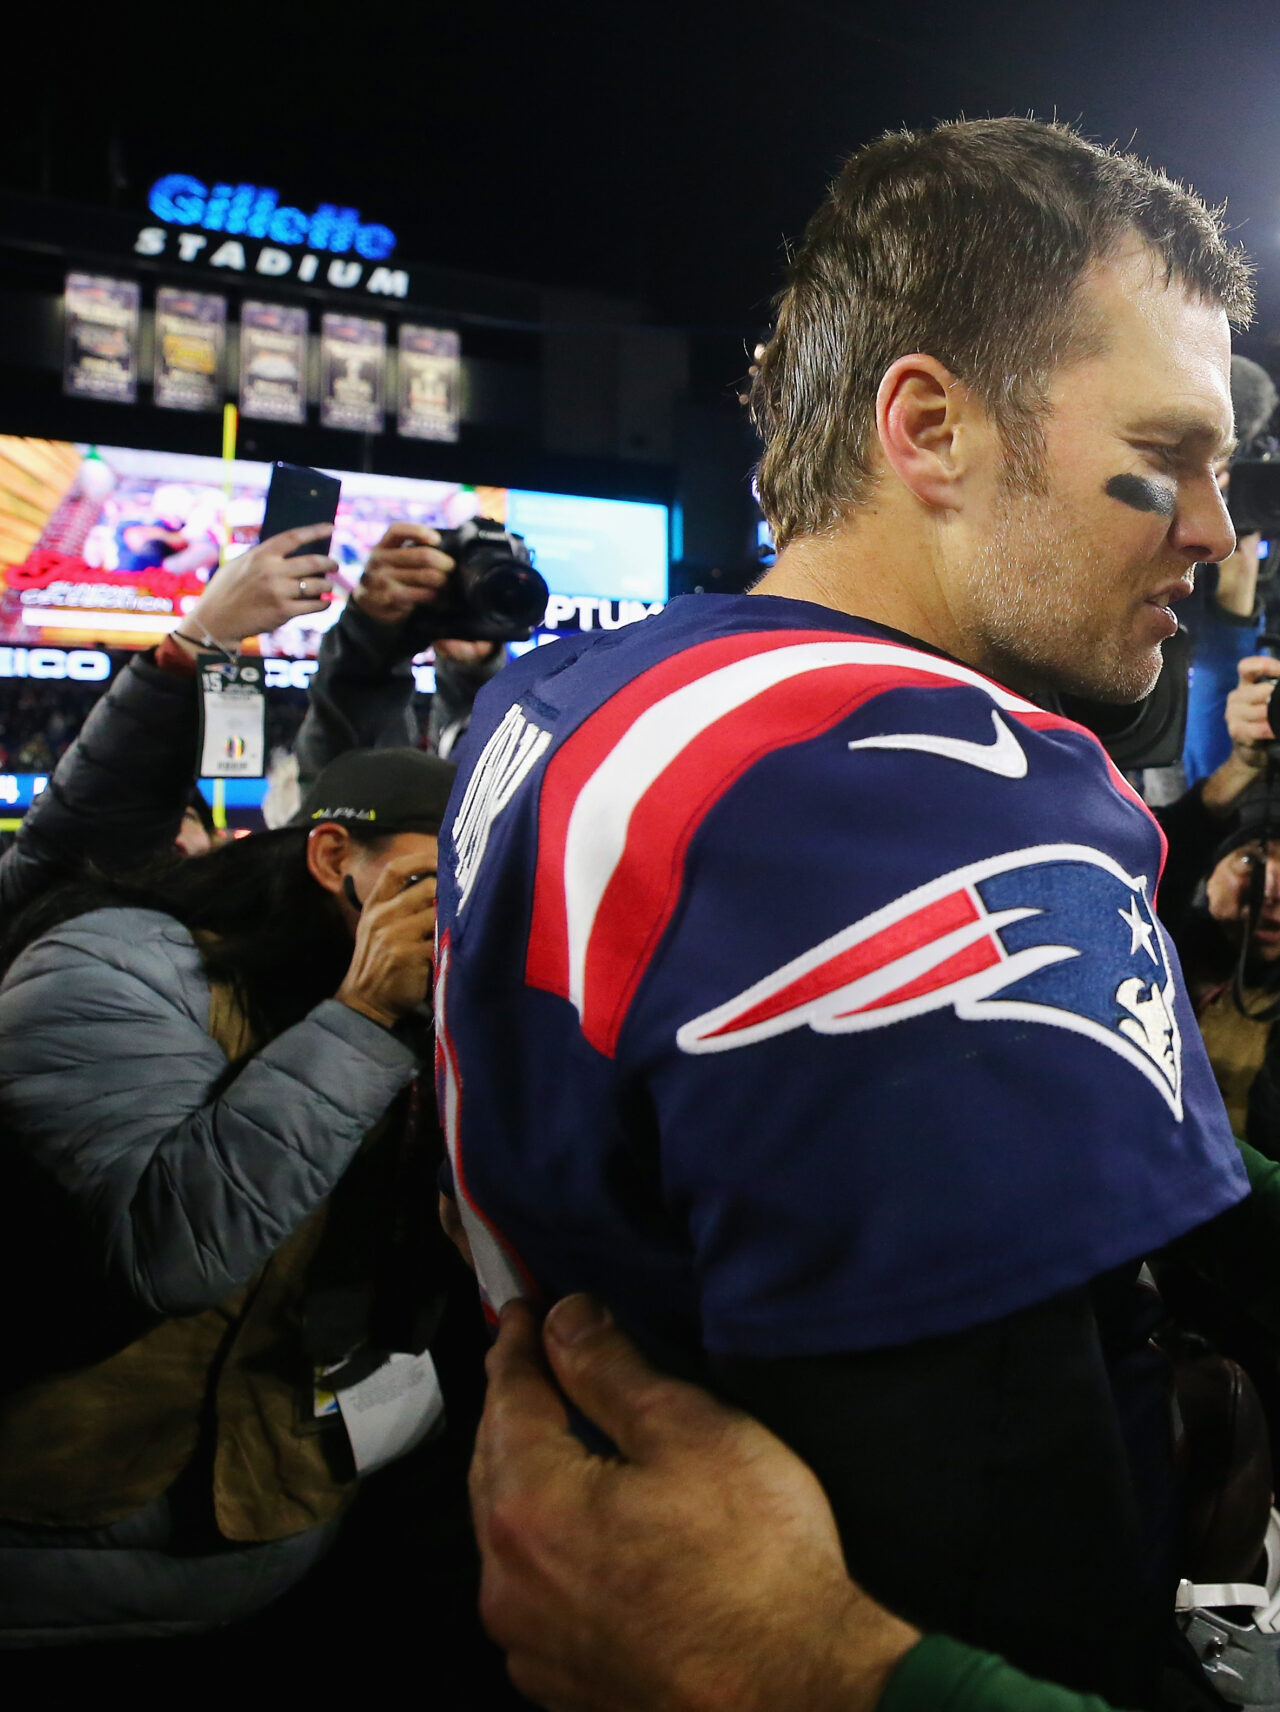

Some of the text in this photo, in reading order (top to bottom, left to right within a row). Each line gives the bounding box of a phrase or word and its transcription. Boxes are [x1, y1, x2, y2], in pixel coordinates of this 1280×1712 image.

[148, 173, 397, 261] Gillette
[134, 227, 410, 299] STADIUM
[544, 594, 667, 631] PTUM
